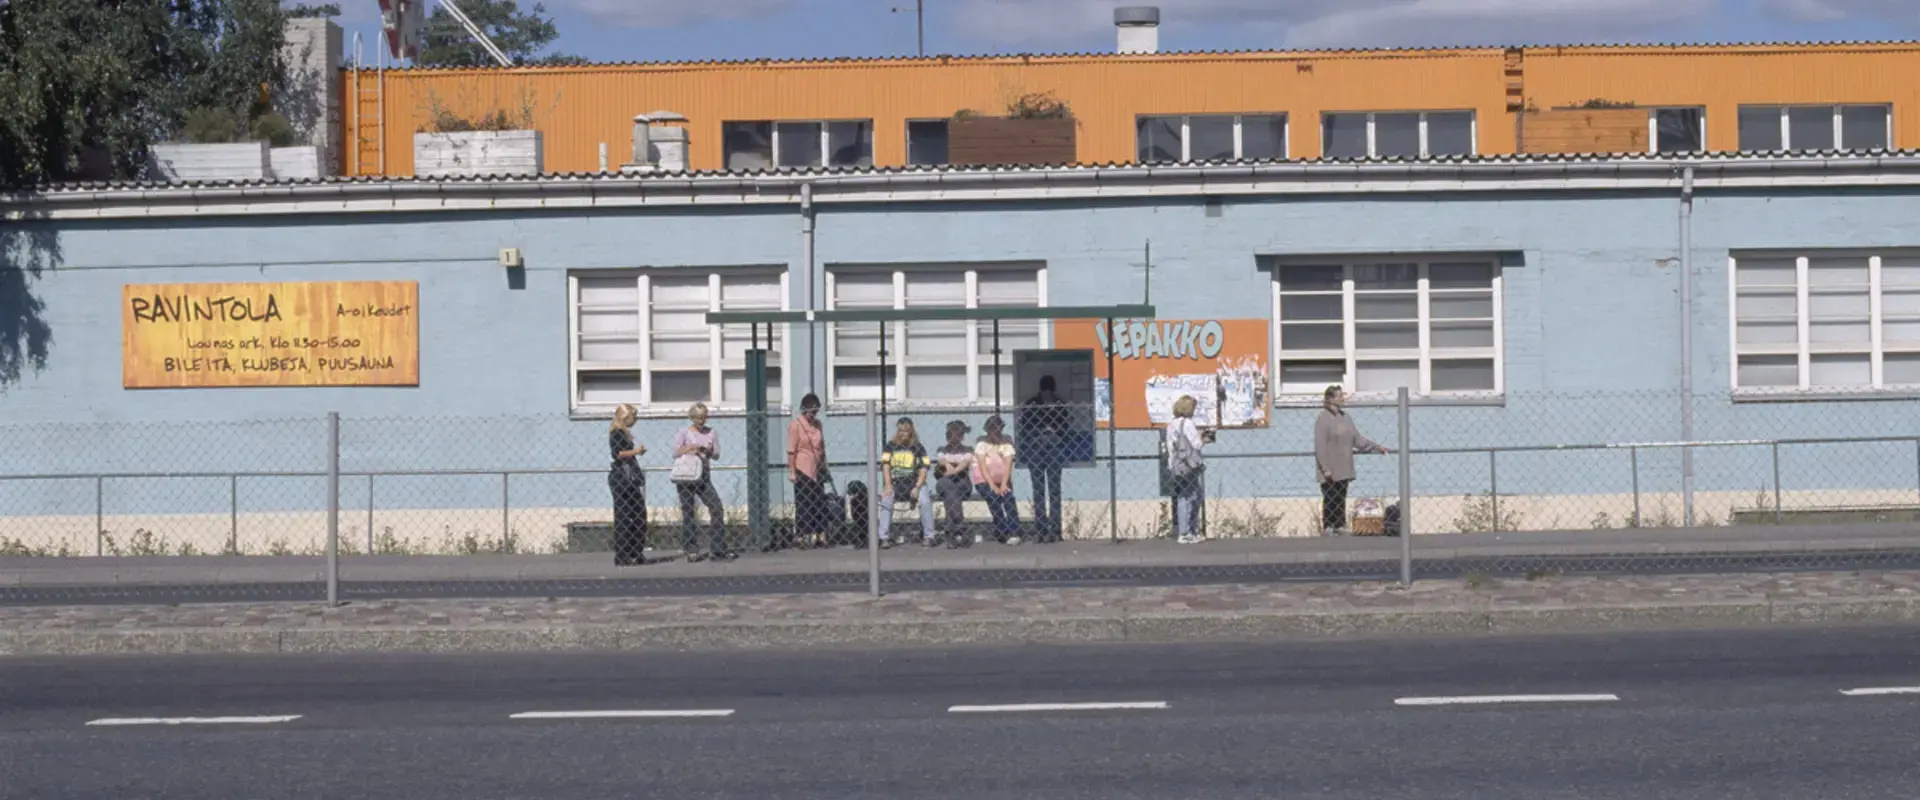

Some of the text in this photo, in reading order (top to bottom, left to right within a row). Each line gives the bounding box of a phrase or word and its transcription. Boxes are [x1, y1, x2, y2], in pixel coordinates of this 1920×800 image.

[131, 293, 283, 323] RAVINTOLA
[186, 337, 235, 350] Lounas
[1096, 319, 1224, 360] LEPAKKO
[242, 357, 312, 374] KLUBEJA,
[318, 355, 394, 371] PUUSAUNA
